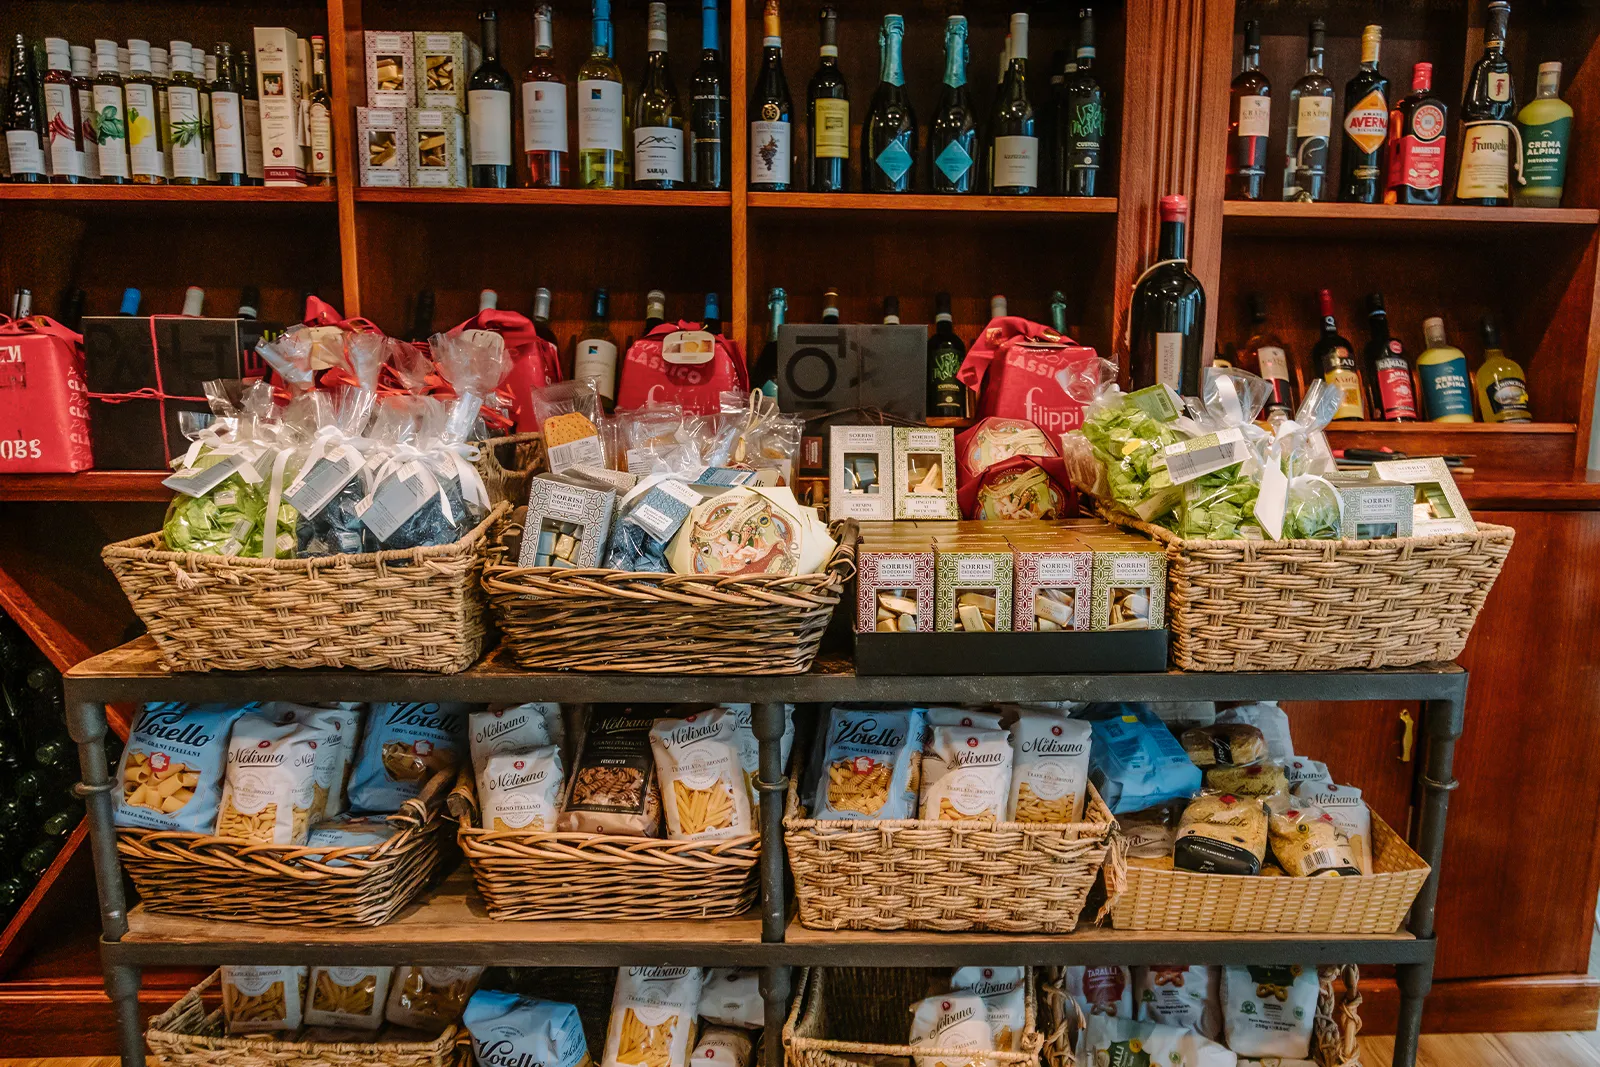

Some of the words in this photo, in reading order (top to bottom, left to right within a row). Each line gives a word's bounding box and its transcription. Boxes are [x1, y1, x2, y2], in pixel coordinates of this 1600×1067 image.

[1349, 117, 1388, 129] AVERNA
[1471, 137, 1508, 153] Frangelic
[1526, 148, 1560, 156] ALPINA
[627, 348, 702, 384] LASSICO
[1005, 352, 1056, 380] LASSI
[1378, 359, 1409, 370] RAMAZZ
[1435, 375, 1465, 384] CREMA
[1435, 381, 1467, 390] ALPINA
[1024, 387, 1079, 431] filippi
[551, 499, 582, 509] CIOCCOLATO
[552, 492, 583, 504] SORRISI
[386, 702, 465, 734] Voiello
[592, 716, 654, 734] Molisana
[134, 709, 215, 747] Voiello
[409, 729, 429, 737] GRANI
[476, 715, 529, 743] Molisana
[663, 719, 724, 749] Molisana
[834, 718, 904, 748] Voiello
[147, 740, 167, 750] GRANI
[168, 744, 201, 757] ITALIANI
[1021, 737, 1085, 754] Molisana
[229, 748, 289, 765] Molisana
[947, 750, 1005, 770] Molisana
[671, 764, 702, 773] TRAFILATA
[1289, 771, 1323, 781] olisana
[489, 771, 548, 790] Molisana
[1308, 792, 1360, 806] Molisana
[120, 808, 138, 818] MEZZA
[138, 813, 159, 823] MANICA
[628, 965, 691, 981] Molisana
[1087, 967, 1117, 978] TARALLI
[971, 982, 1017, 998] Molisana
[929, 1006, 976, 1040] Molisana
[476, 1039, 544, 1067] Voiello
